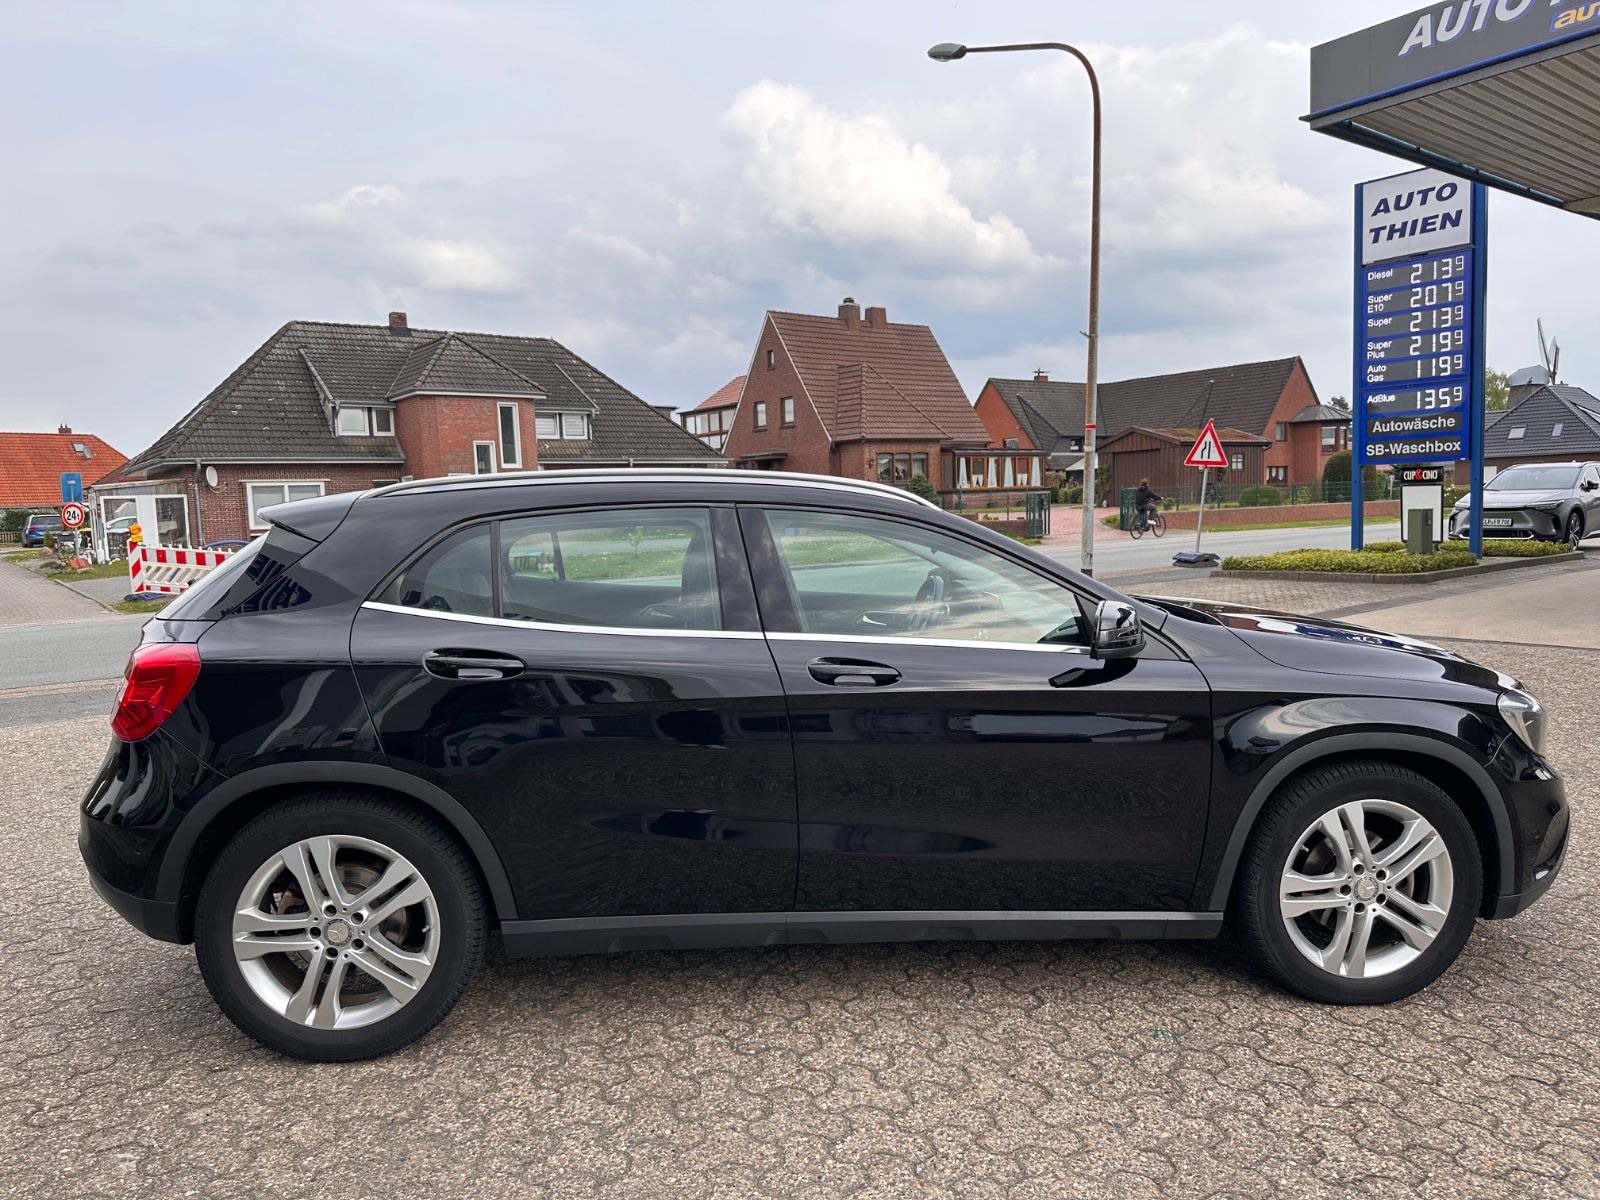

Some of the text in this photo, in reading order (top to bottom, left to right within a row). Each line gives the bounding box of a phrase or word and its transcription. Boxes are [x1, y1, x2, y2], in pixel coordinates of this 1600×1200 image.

[1398, 0, 1534, 56] AUTO
[1371, 182, 1458, 217] AUTO
[1369, 209, 1463, 244] THIEN
[1367, 268, 1394, 281] Diesel
[1367, 293, 1393, 304] Super
[1367, 303, 1384, 314] E10
[1367, 317, 1392, 327] Super
[1367, 340, 1392, 351] Super
[1367, 350, 1385, 360] Plus
[1367, 364, 1387, 373] Auto
[1367, 374, 1384, 382] Gas
[1366, 393, 1396, 404] AdBlue
[1372, 416, 1456, 432] Autowäsche
[1366, 440, 1461, 456] SB-Waschbox
